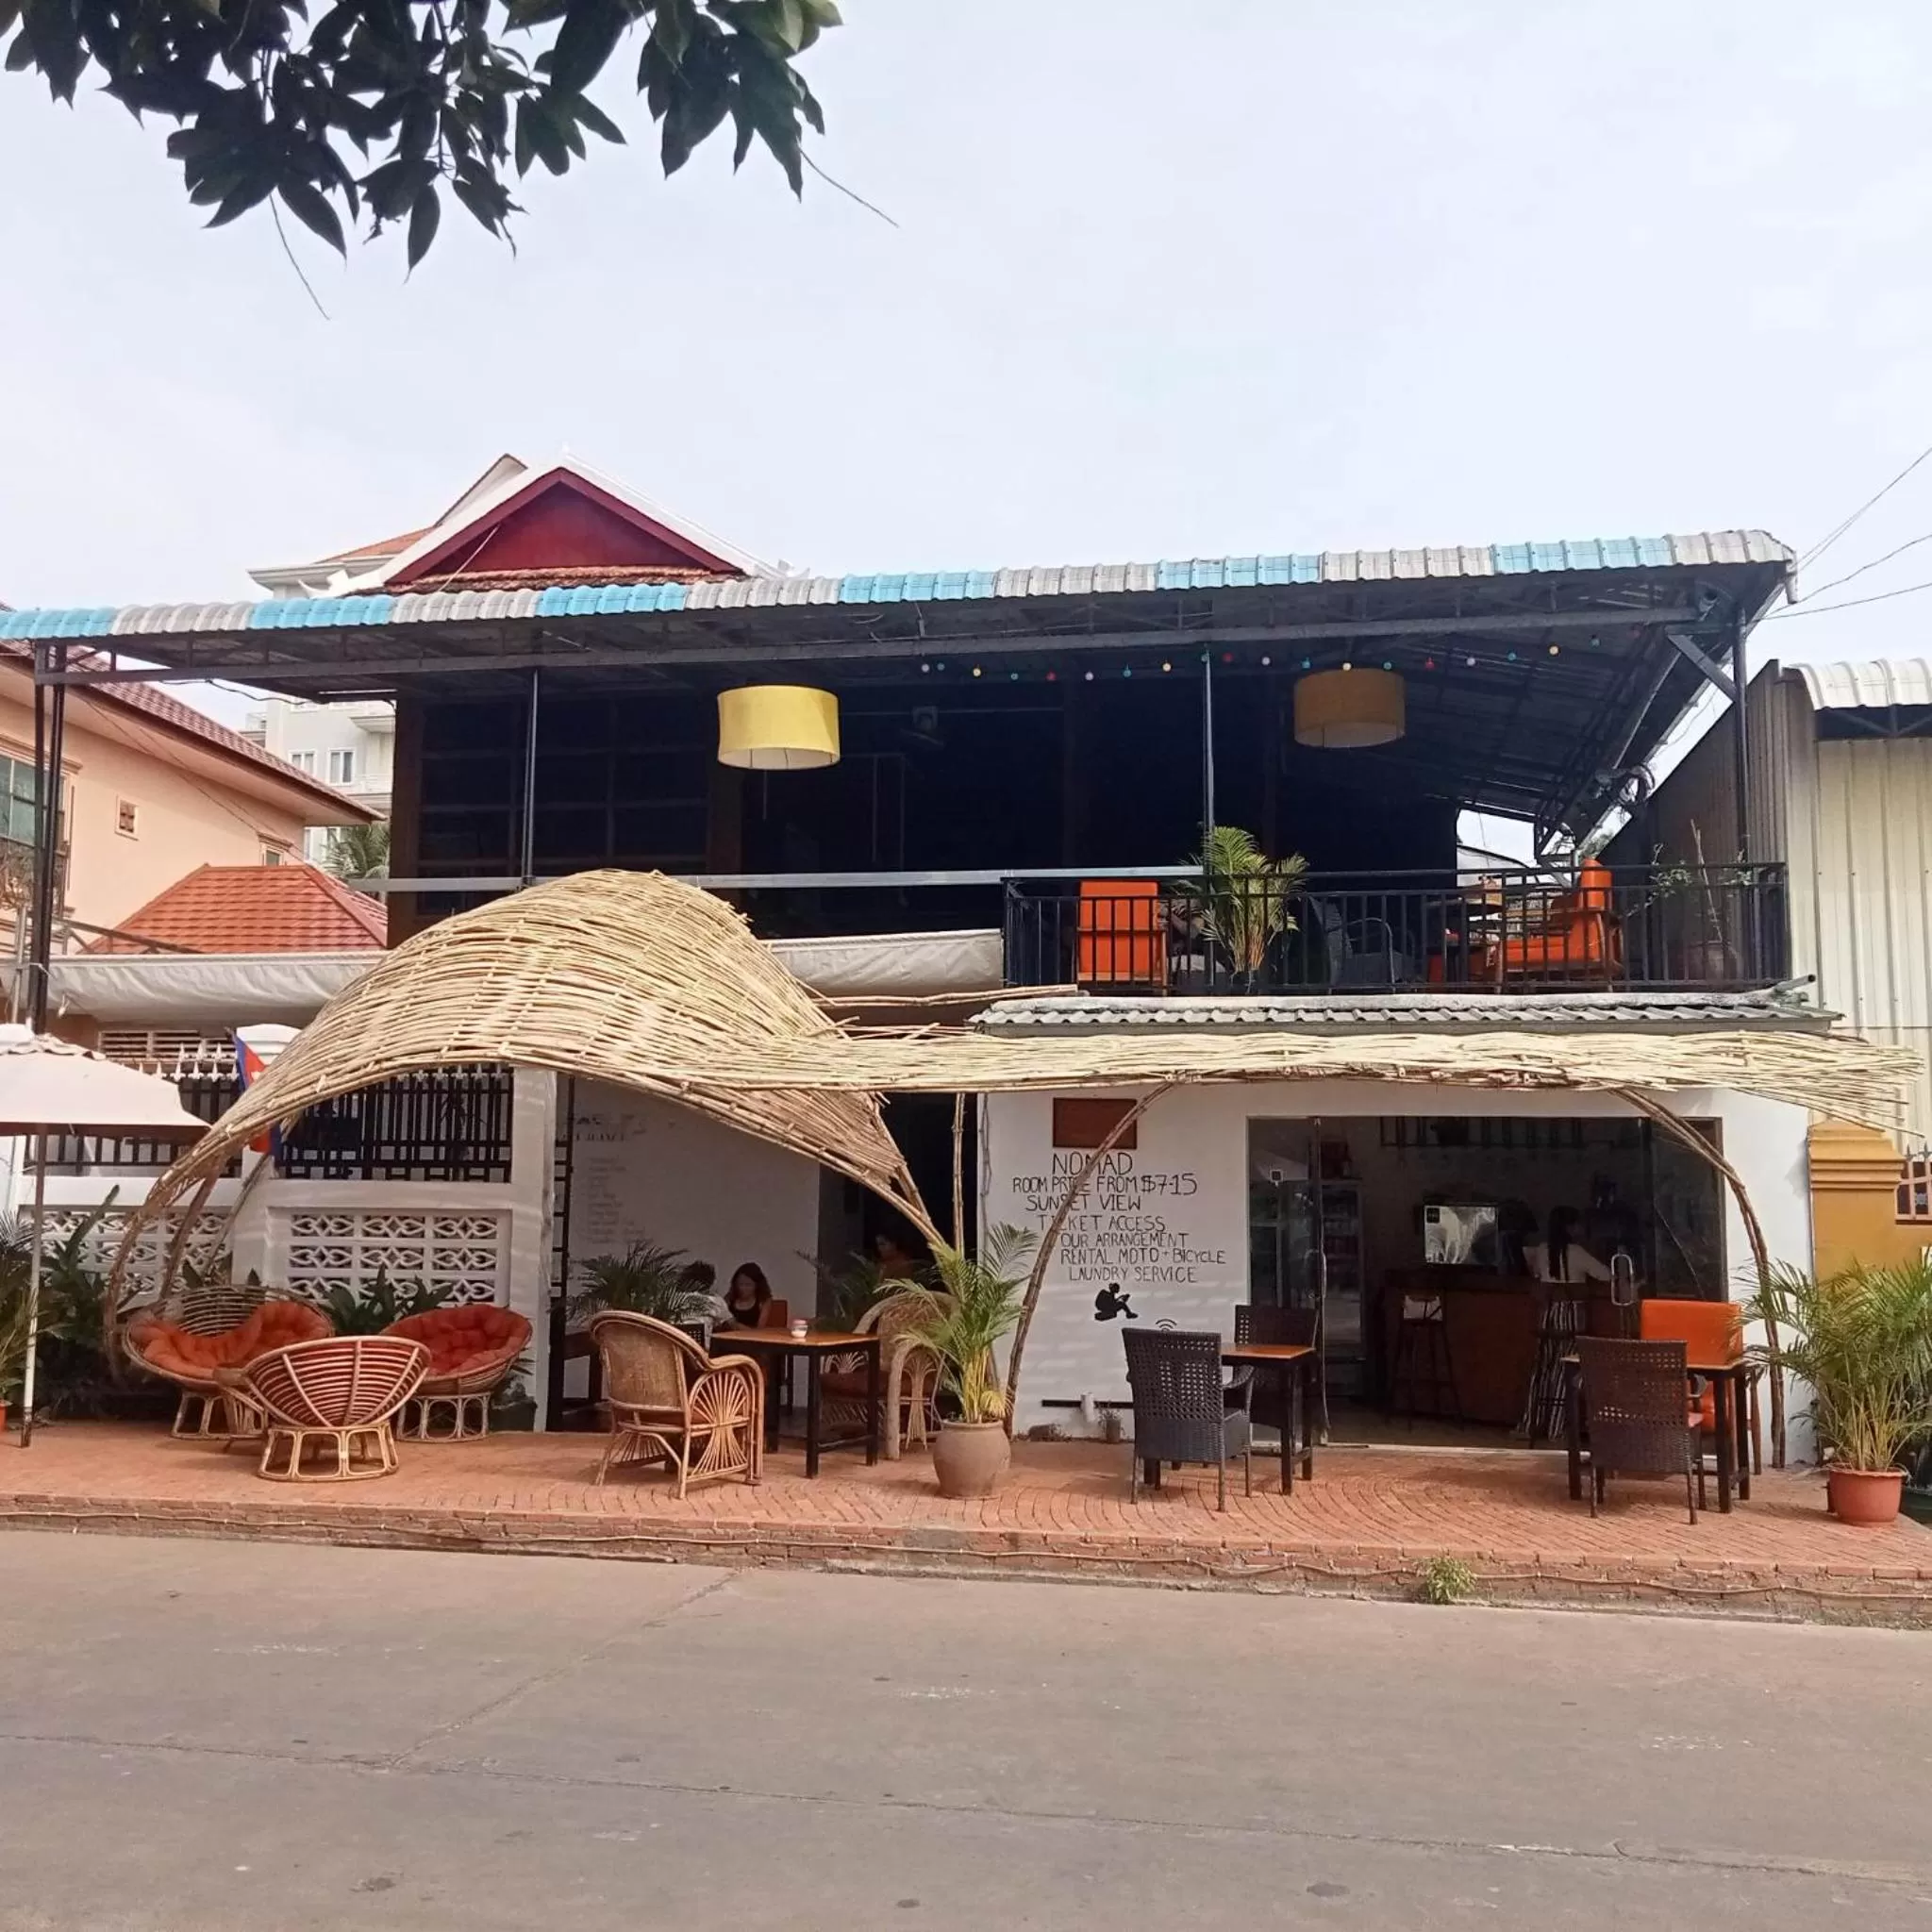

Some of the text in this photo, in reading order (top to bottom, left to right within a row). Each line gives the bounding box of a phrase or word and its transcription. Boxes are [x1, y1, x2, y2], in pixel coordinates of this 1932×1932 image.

[1013, 1176, 1048, 1193] ROOM
[1097, 1176, 1138, 1193] FROM
[1099, 1193, 1141, 1211] VIEW
[1038, 1214, 1166, 1232] TKET ACCESS
[1095, 1232, 1190, 1249] ARRANGEMENT
[1060, 1248, 1113, 1265] RENTAL
[1119, 1248, 1159, 1265] MOTO
[1172, 1248, 1226, 1264] BICYCLE
[1069, 1266, 1198, 1283] LAUNDRY SERVICE
